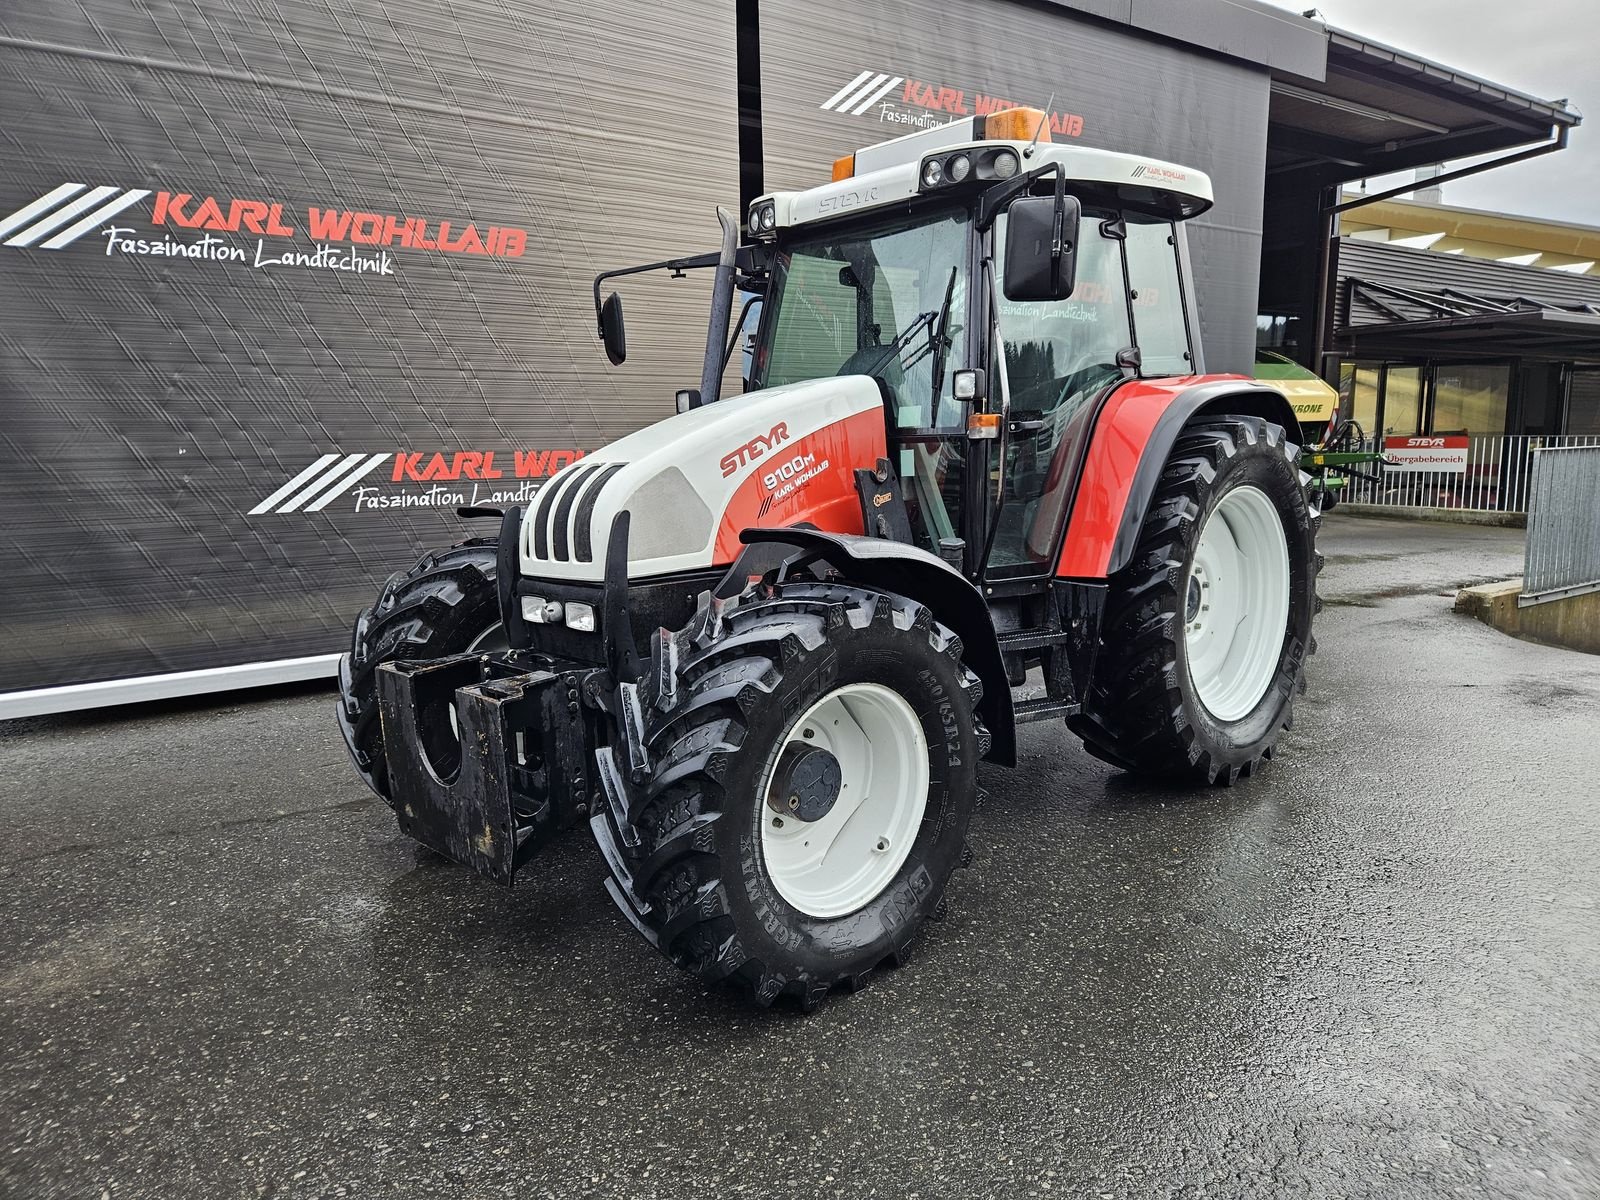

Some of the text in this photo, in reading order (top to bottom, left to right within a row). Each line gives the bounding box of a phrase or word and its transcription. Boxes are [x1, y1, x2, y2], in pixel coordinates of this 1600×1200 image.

[901, 79, 968, 115] KARL
[152, 191, 294, 237] KARL
[102, 225, 394, 275] Faszination Landtechnik
[720, 421, 790, 479] STEYR
[1387, 453, 1464, 464] Übergabebereich
[1406, 438, 1445, 447] STEYR
[392, 452, 503, 482] KARL
[352, 481, 540, 513] Faszination Landte
[774, 483, 795, 500] KARL
